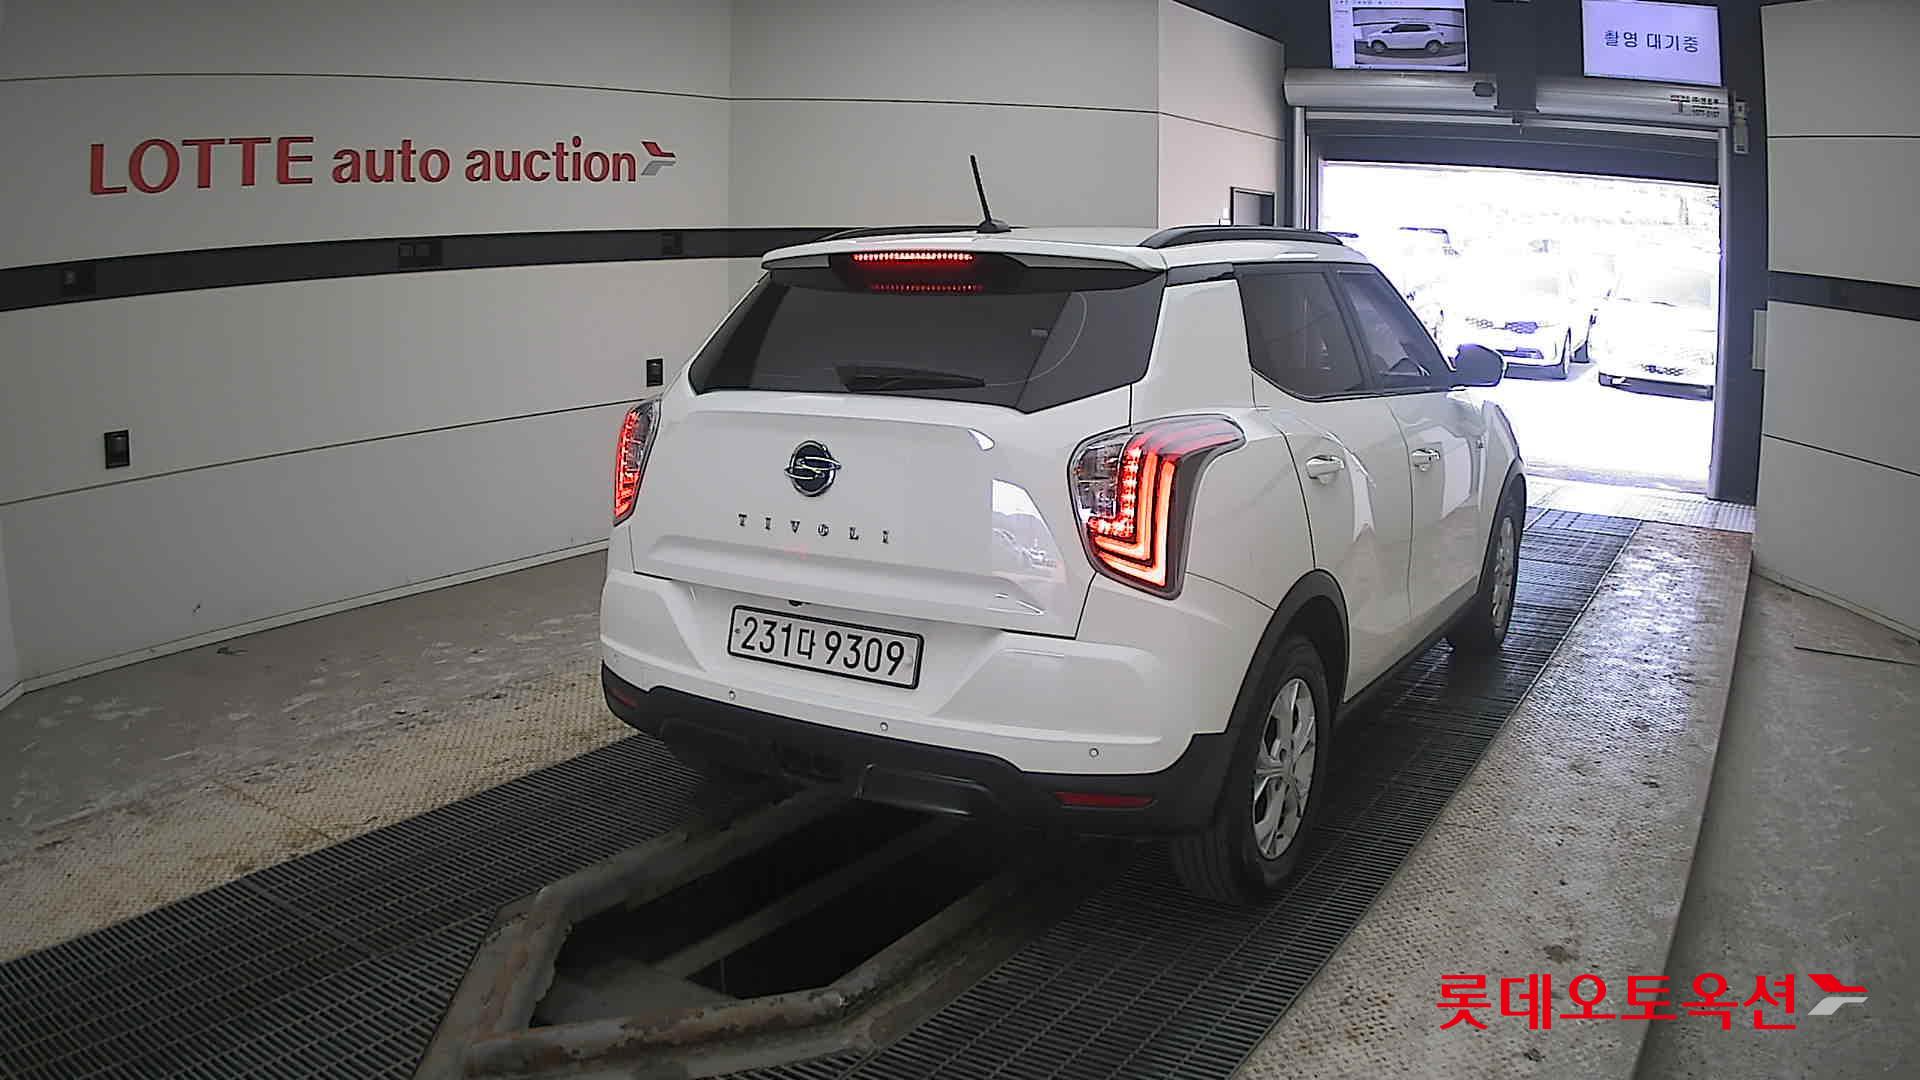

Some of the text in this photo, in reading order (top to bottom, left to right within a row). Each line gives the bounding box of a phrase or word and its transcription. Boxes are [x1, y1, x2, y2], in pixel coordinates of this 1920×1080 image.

[1646, 32, 1698, 53] 대기중
[90, 136, 638, 195] LOTTE auto auction
[737, 513, 889, 545] TIVOLI
